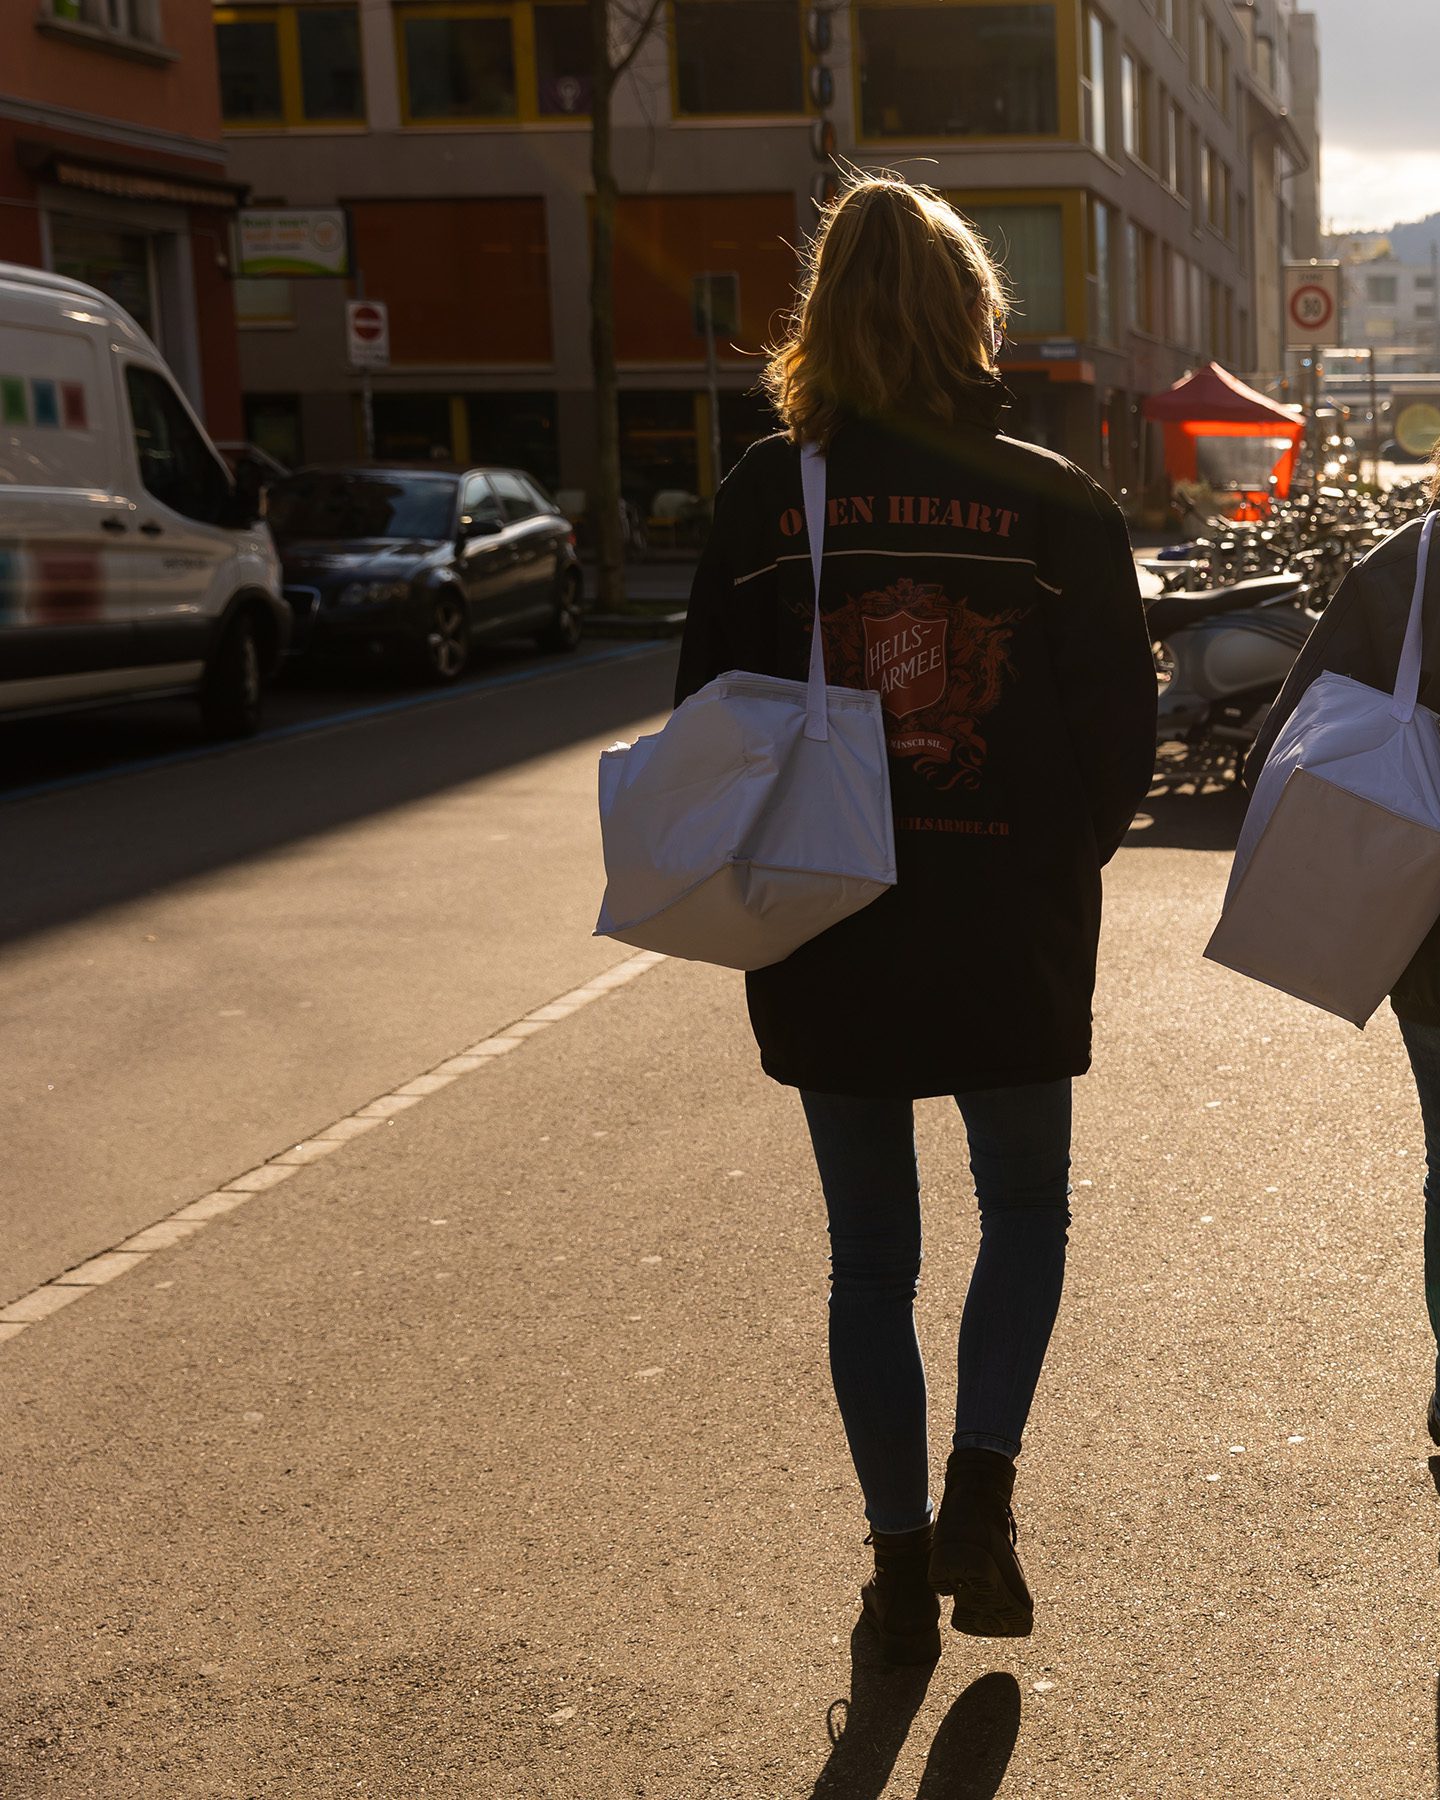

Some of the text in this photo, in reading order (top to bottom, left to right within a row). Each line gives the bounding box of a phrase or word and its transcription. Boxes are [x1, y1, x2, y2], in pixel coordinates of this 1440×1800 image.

[1302, 296, 1322, 317] 30
[779, 495, 1019, 537] OEN HEART
[869, 624, 932, 678] HEILS-
[881, 644, 942, 698] ARMEE
